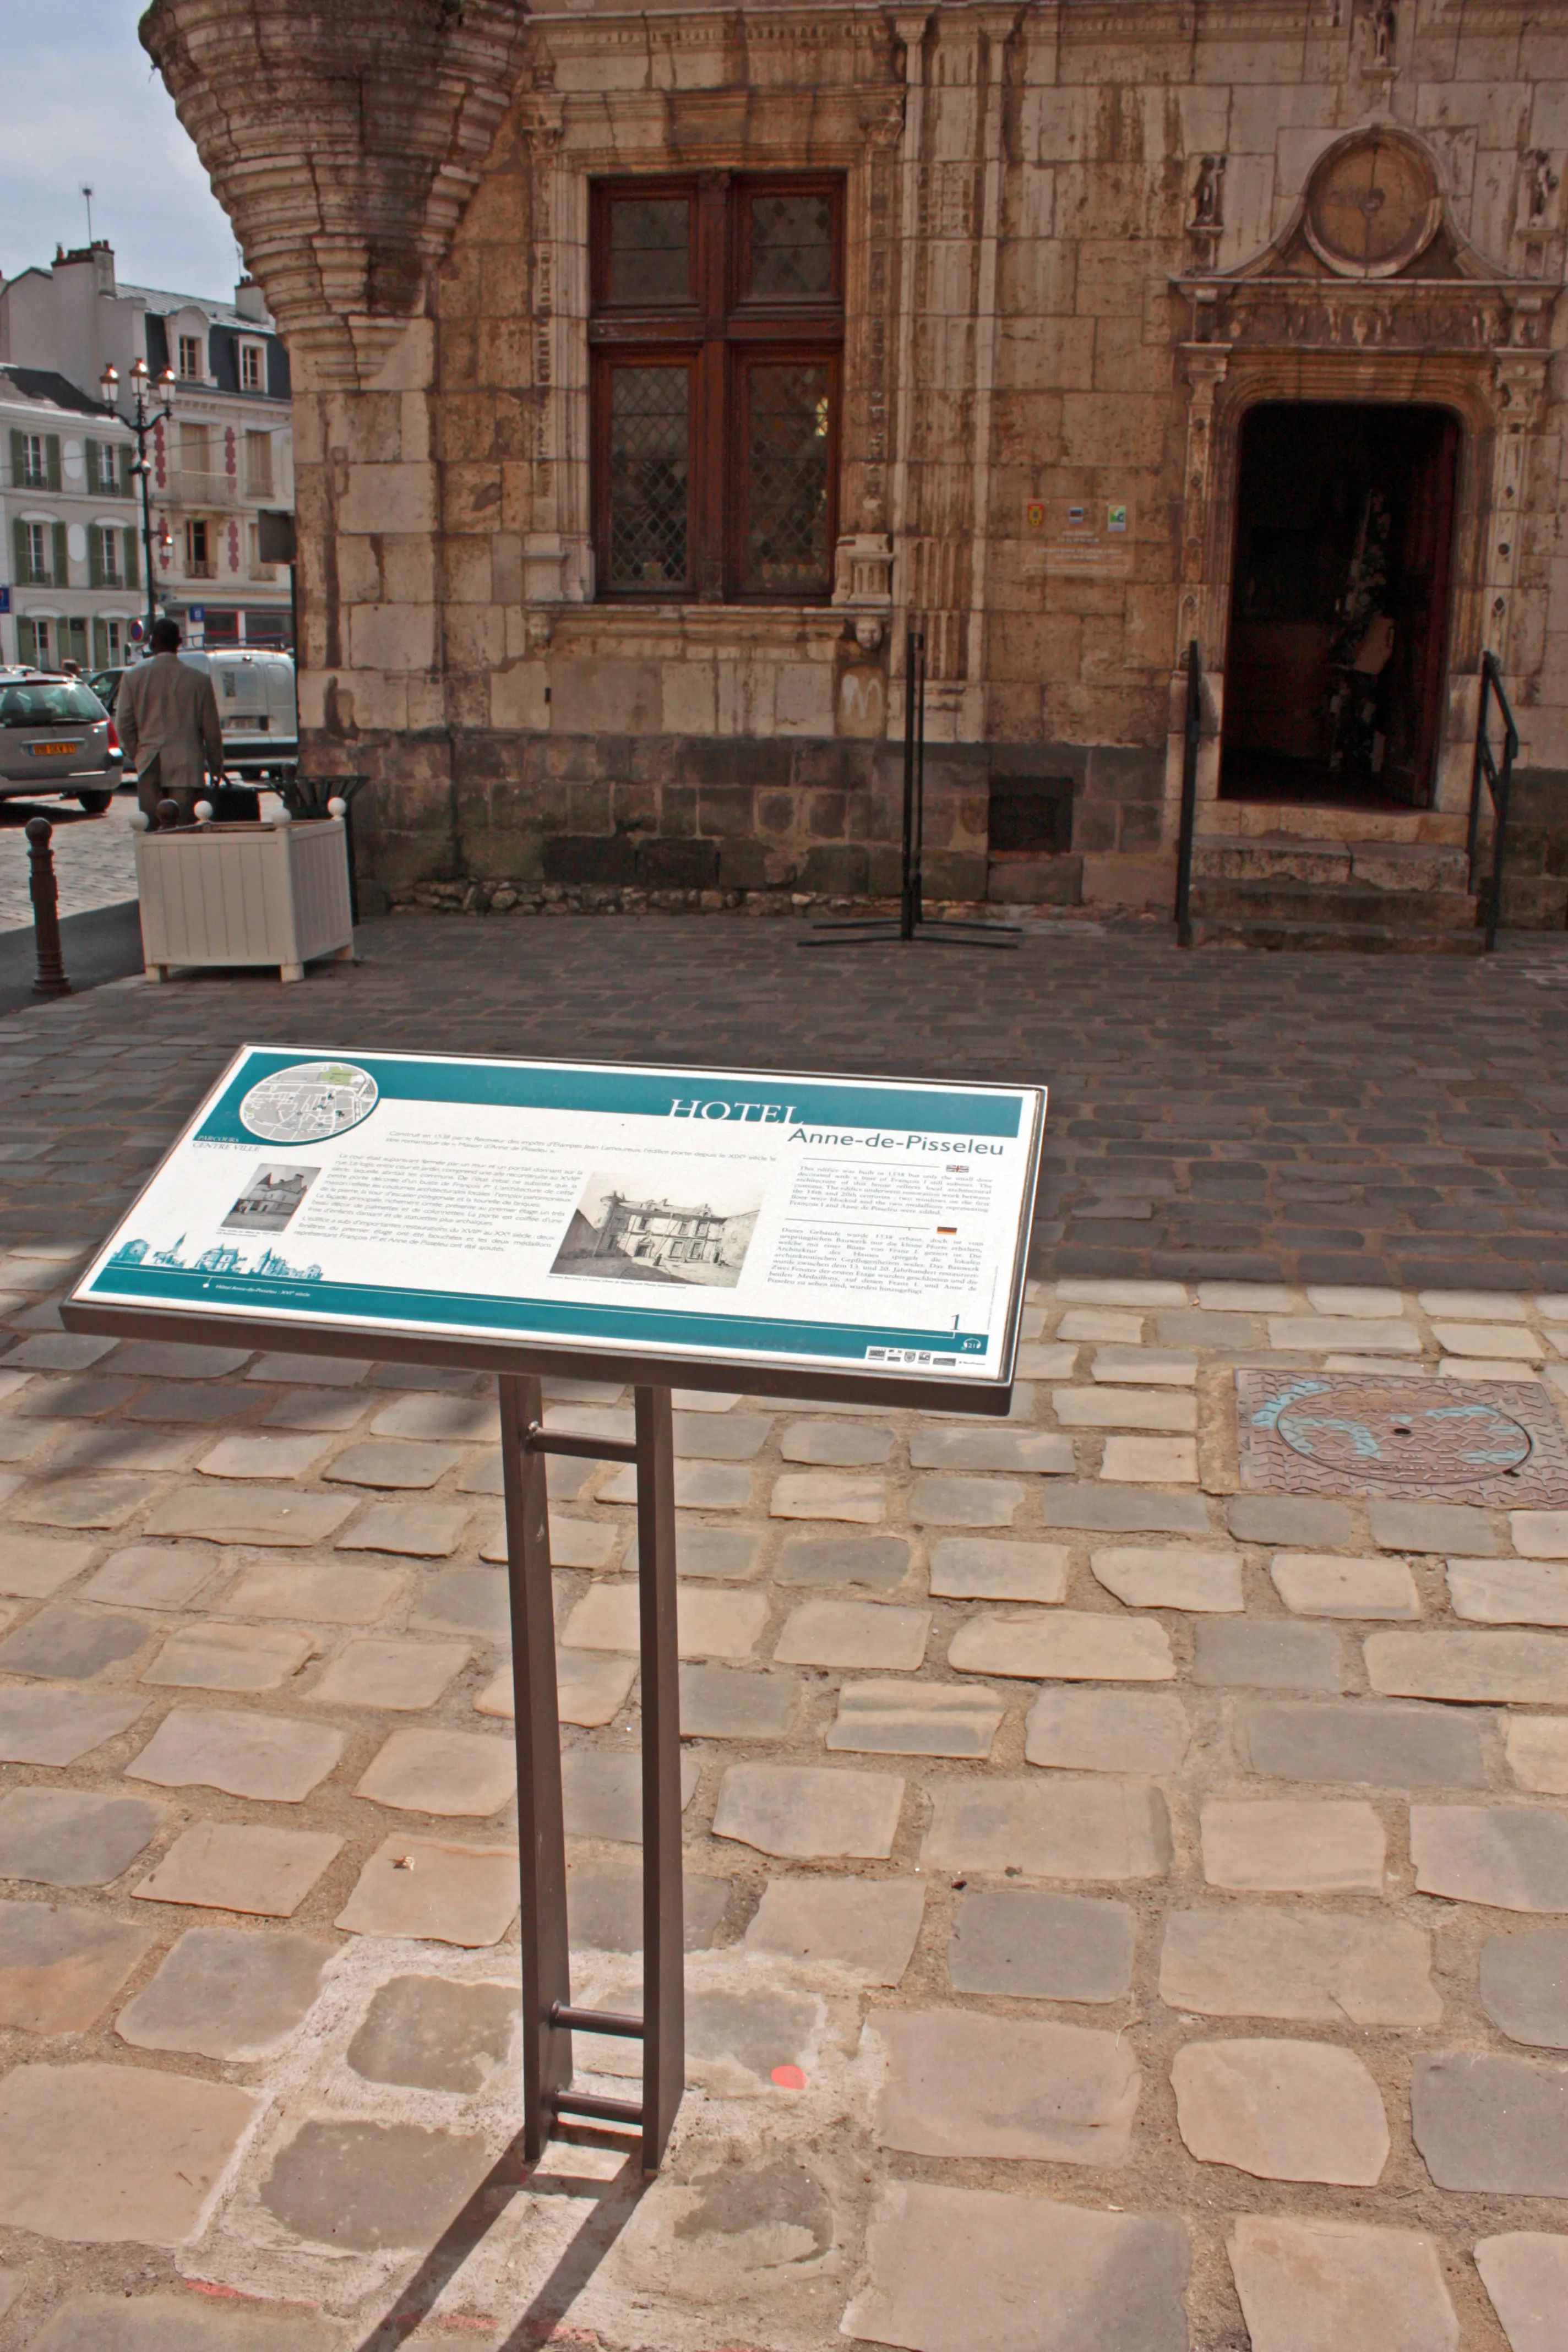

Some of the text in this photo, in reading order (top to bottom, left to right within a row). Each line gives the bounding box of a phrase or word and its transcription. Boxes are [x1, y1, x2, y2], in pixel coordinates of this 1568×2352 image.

[668, 1099, 804, 1125] HOTEL
[787, 1128, 1003, 1155] Anne-de-Pisseleu
[950, 1314, 961, 1330] 1
